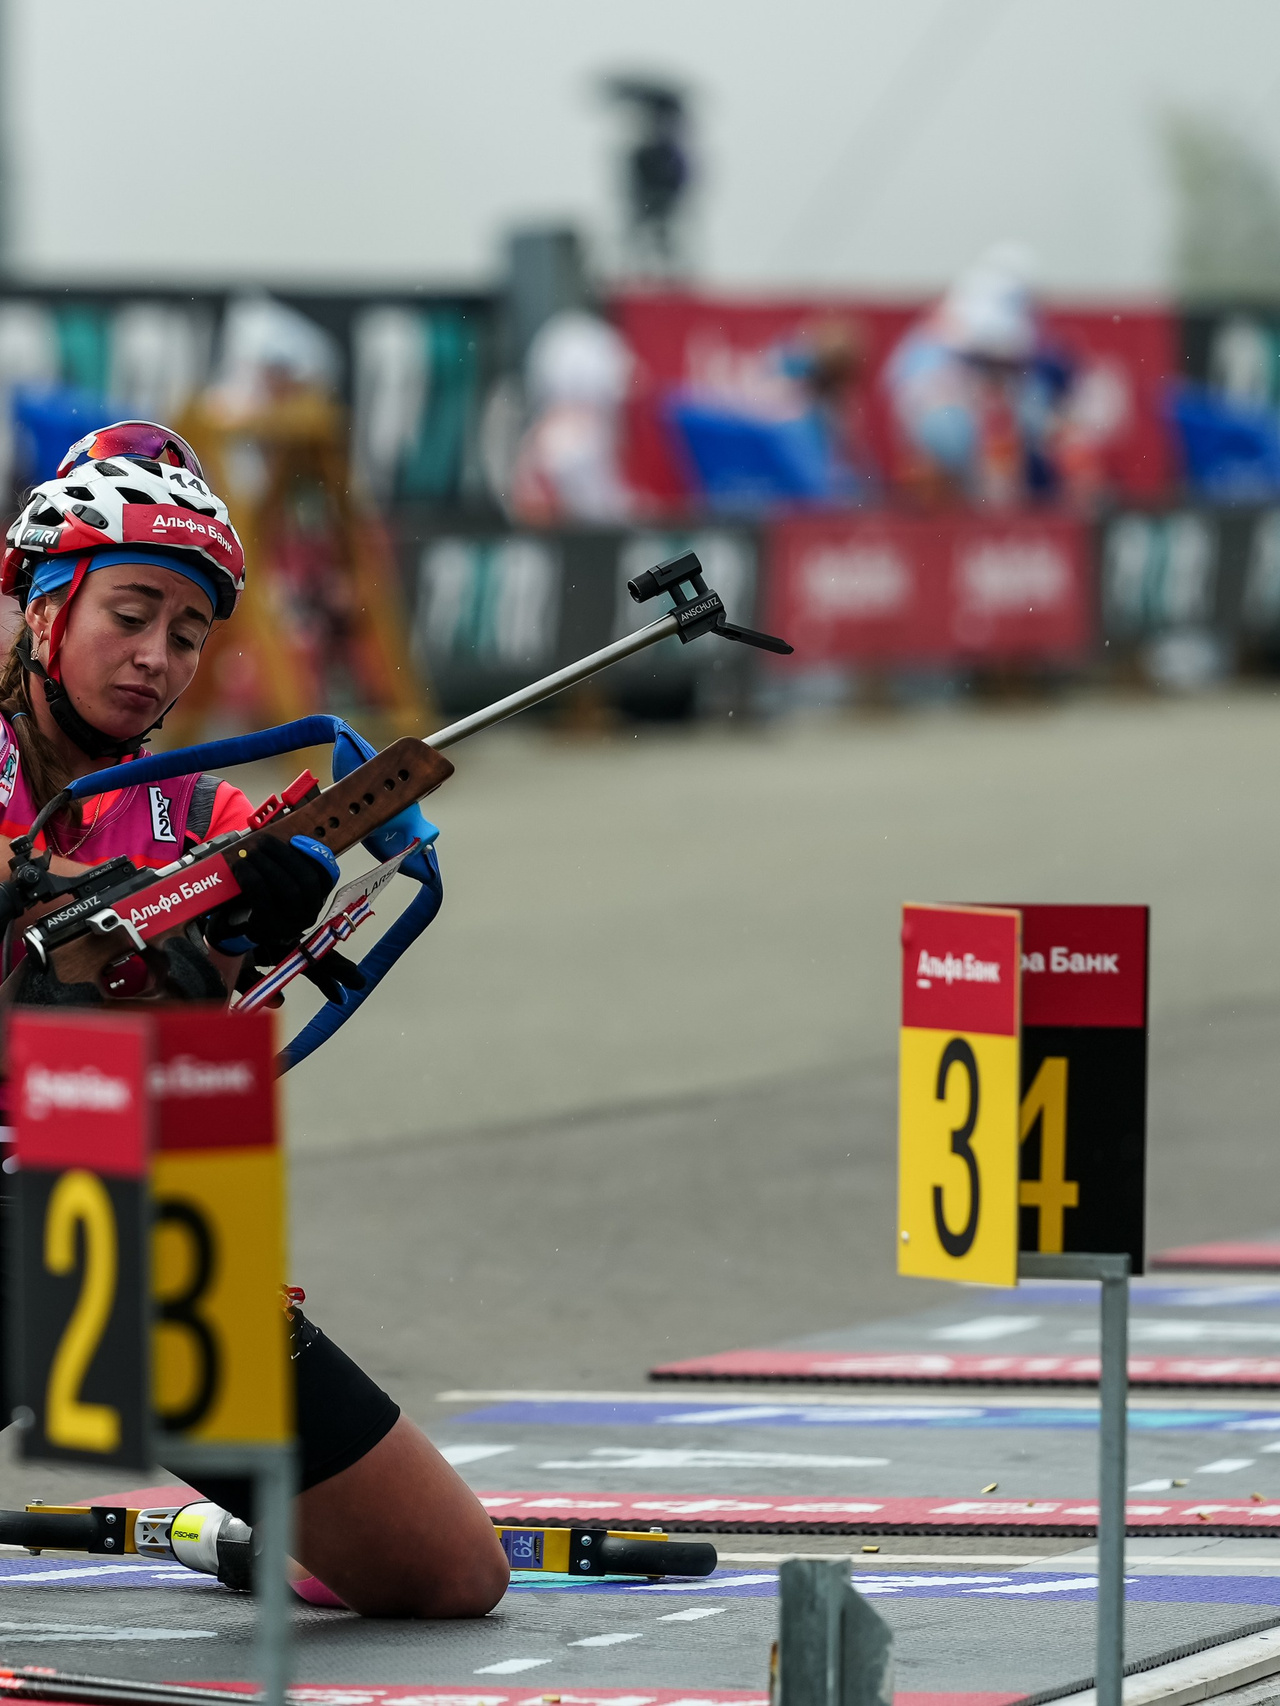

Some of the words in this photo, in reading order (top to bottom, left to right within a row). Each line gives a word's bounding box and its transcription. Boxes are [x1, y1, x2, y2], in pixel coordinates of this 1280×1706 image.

[170, 473, 207, 497] 14
[22, 528, 58, 545] PARI
[153, 514, 206, 534] Альфа
[207, 523, 233, 555] Банк
[129, 891, 183, 925] Альфа
[179, 871, 223, 901] Банк
[1050, 946, 1119, 974] Банк
[932, 1037, 981, 1258] 3
[1019, 1055, 1079, 1254] 4
[43, 1168, 119, 1454] 2
[173, 1530, 199, 1540] FISCHER
